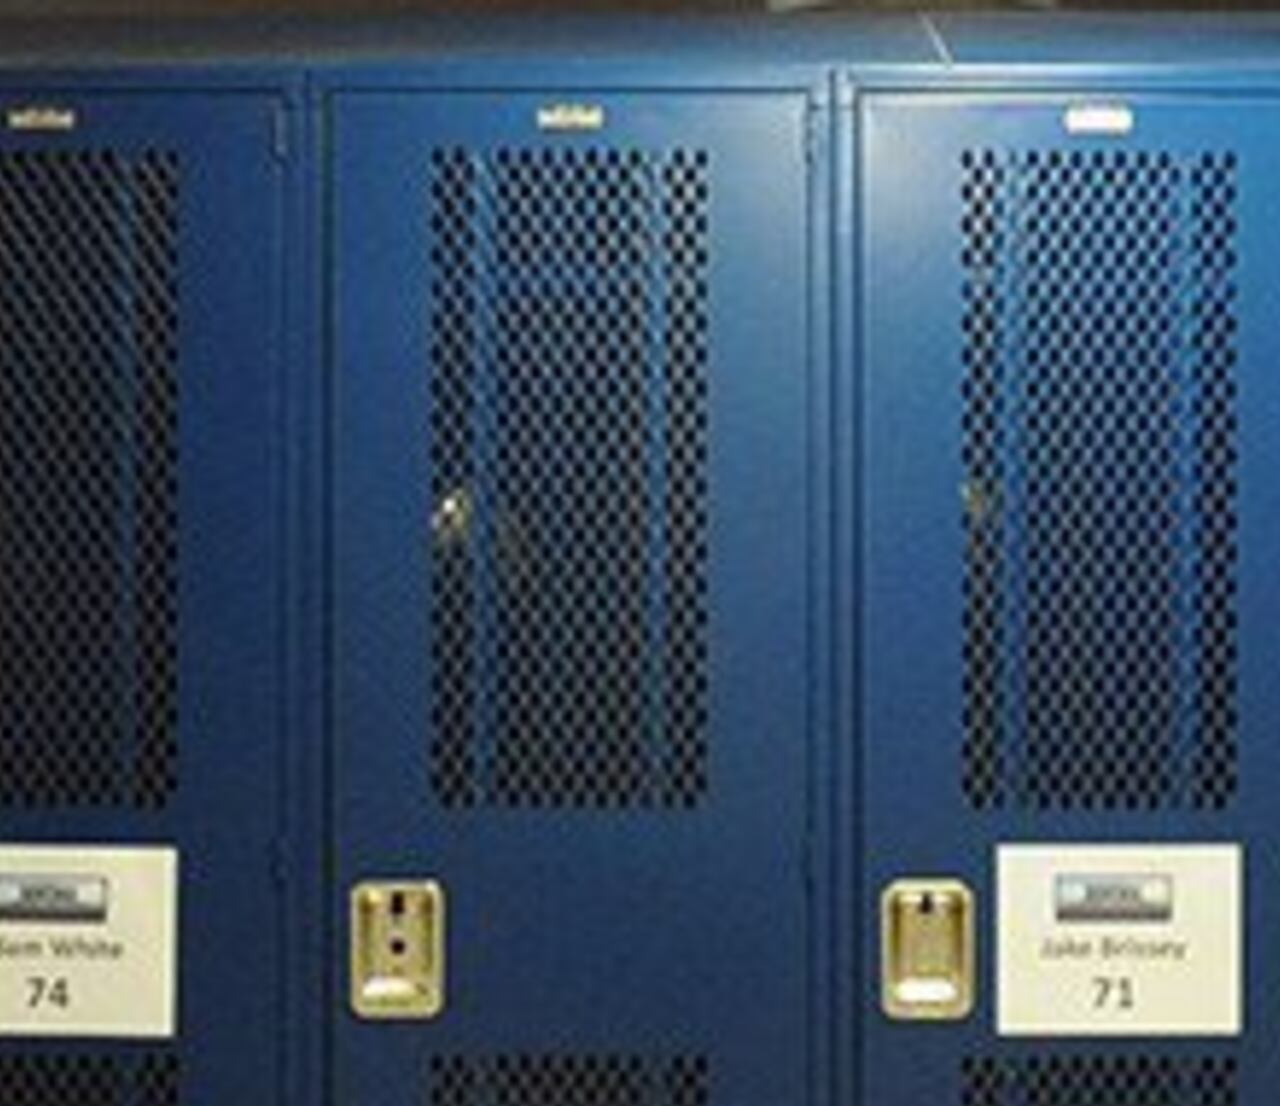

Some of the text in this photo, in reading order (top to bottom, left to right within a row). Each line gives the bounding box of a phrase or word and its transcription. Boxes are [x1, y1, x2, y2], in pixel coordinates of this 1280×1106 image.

[48, 935, 126, 960] White
[1040, 935, 1094, 960] Jake
[25, 975, 71, 1009] 74
[1091, 975, 1135, 1010] 71
